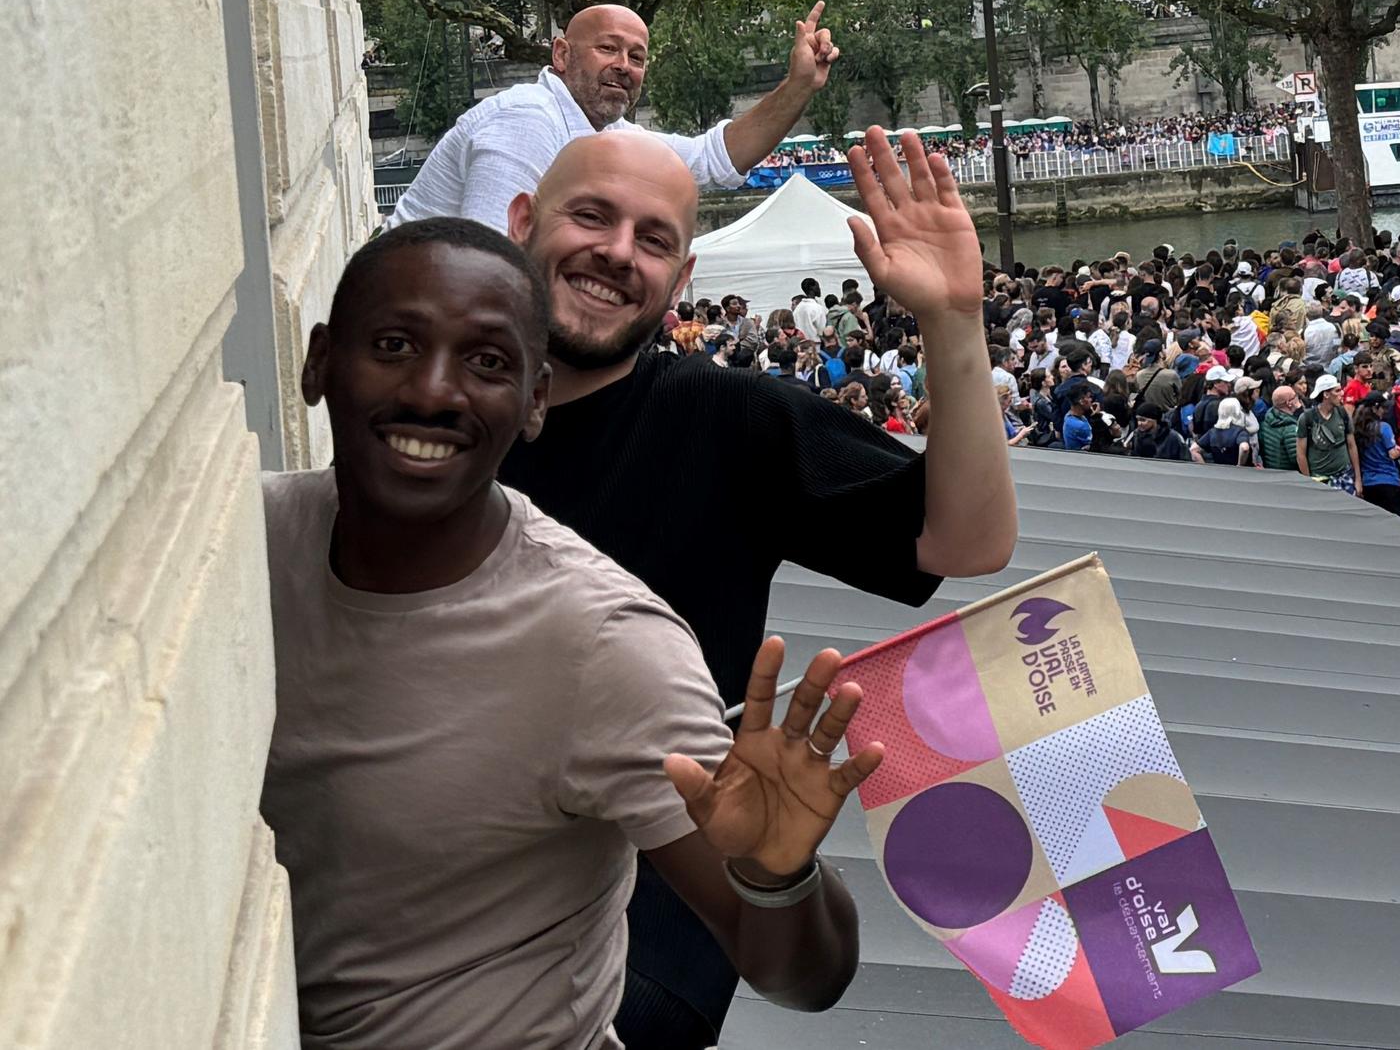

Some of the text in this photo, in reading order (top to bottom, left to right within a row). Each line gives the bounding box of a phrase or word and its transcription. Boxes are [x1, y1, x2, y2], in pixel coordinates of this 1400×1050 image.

[1021, 651, 1057, 717] D'OISE
[1039, 644, 1065, 684] VAL
[1057, 639, 1082, 691] PASSE EN
[1068, 634, 1098, 698] LA FLAMME
[1113, 881, 1163, 1000] le département
[1125, 876, 1157, 941] d'oise
[1153, 900, 1176, 935] val
